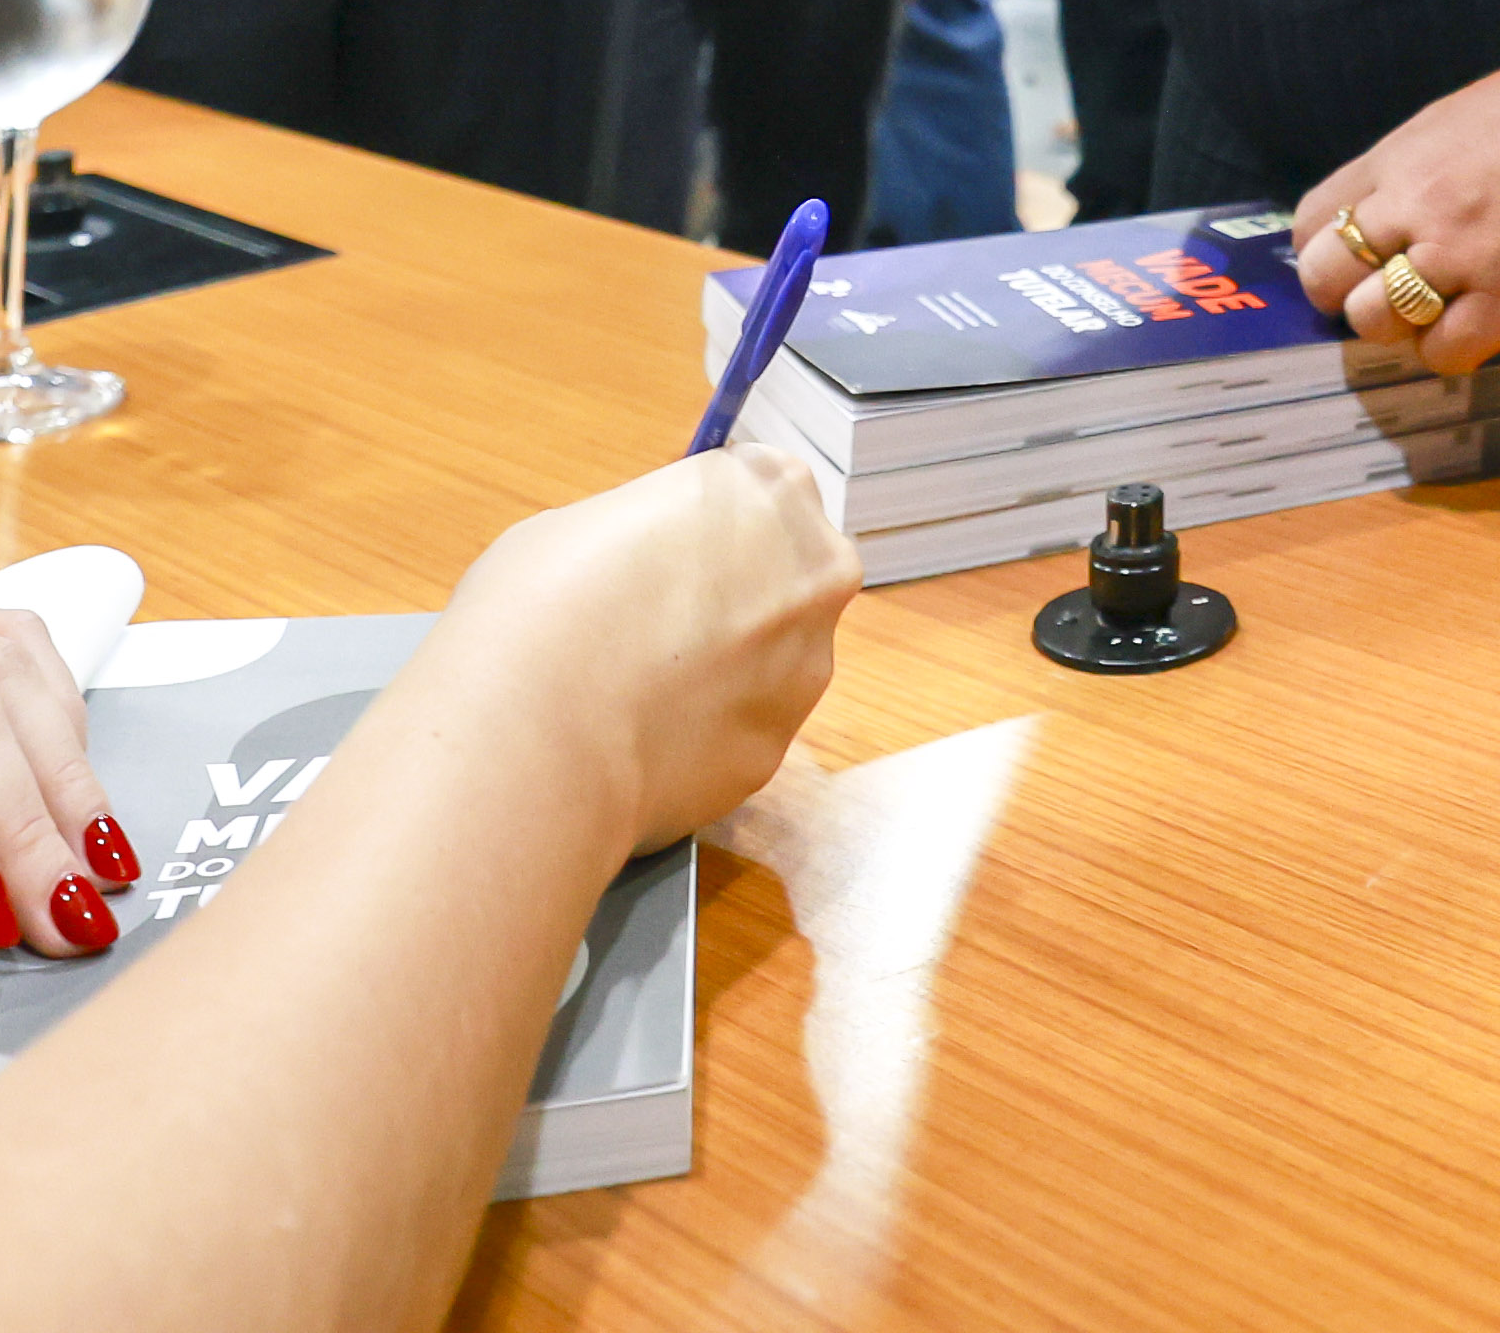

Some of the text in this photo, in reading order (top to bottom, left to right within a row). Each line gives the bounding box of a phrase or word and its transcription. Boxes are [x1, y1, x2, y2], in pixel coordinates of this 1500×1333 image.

[997, 267, 1108, 333] TUTELAR
[1134, 248, 1269, 315] VADE
[157, 857, 235, 882] DO
